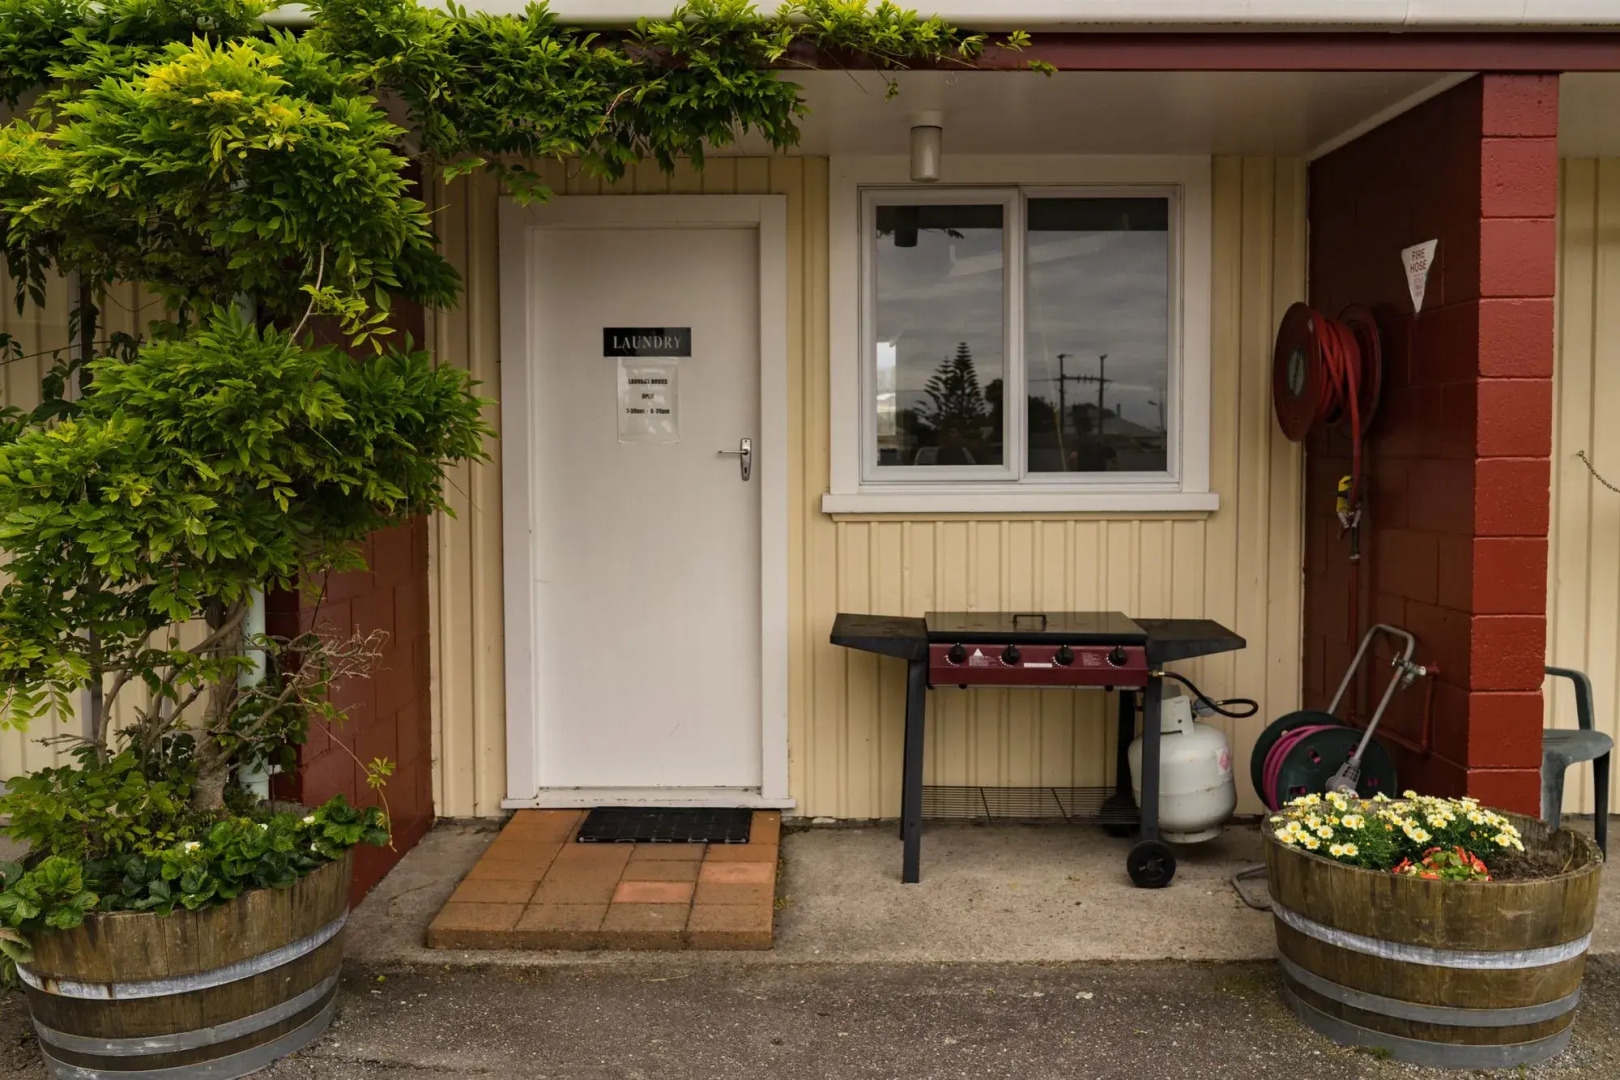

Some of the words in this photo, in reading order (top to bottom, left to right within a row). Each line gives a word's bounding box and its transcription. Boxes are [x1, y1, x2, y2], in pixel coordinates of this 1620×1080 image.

[1412, 248, 1425, 261] FIRE
[1410, 259, 1427, 273] HOSE
[613, 335, 681, 350] LAUNDRY
